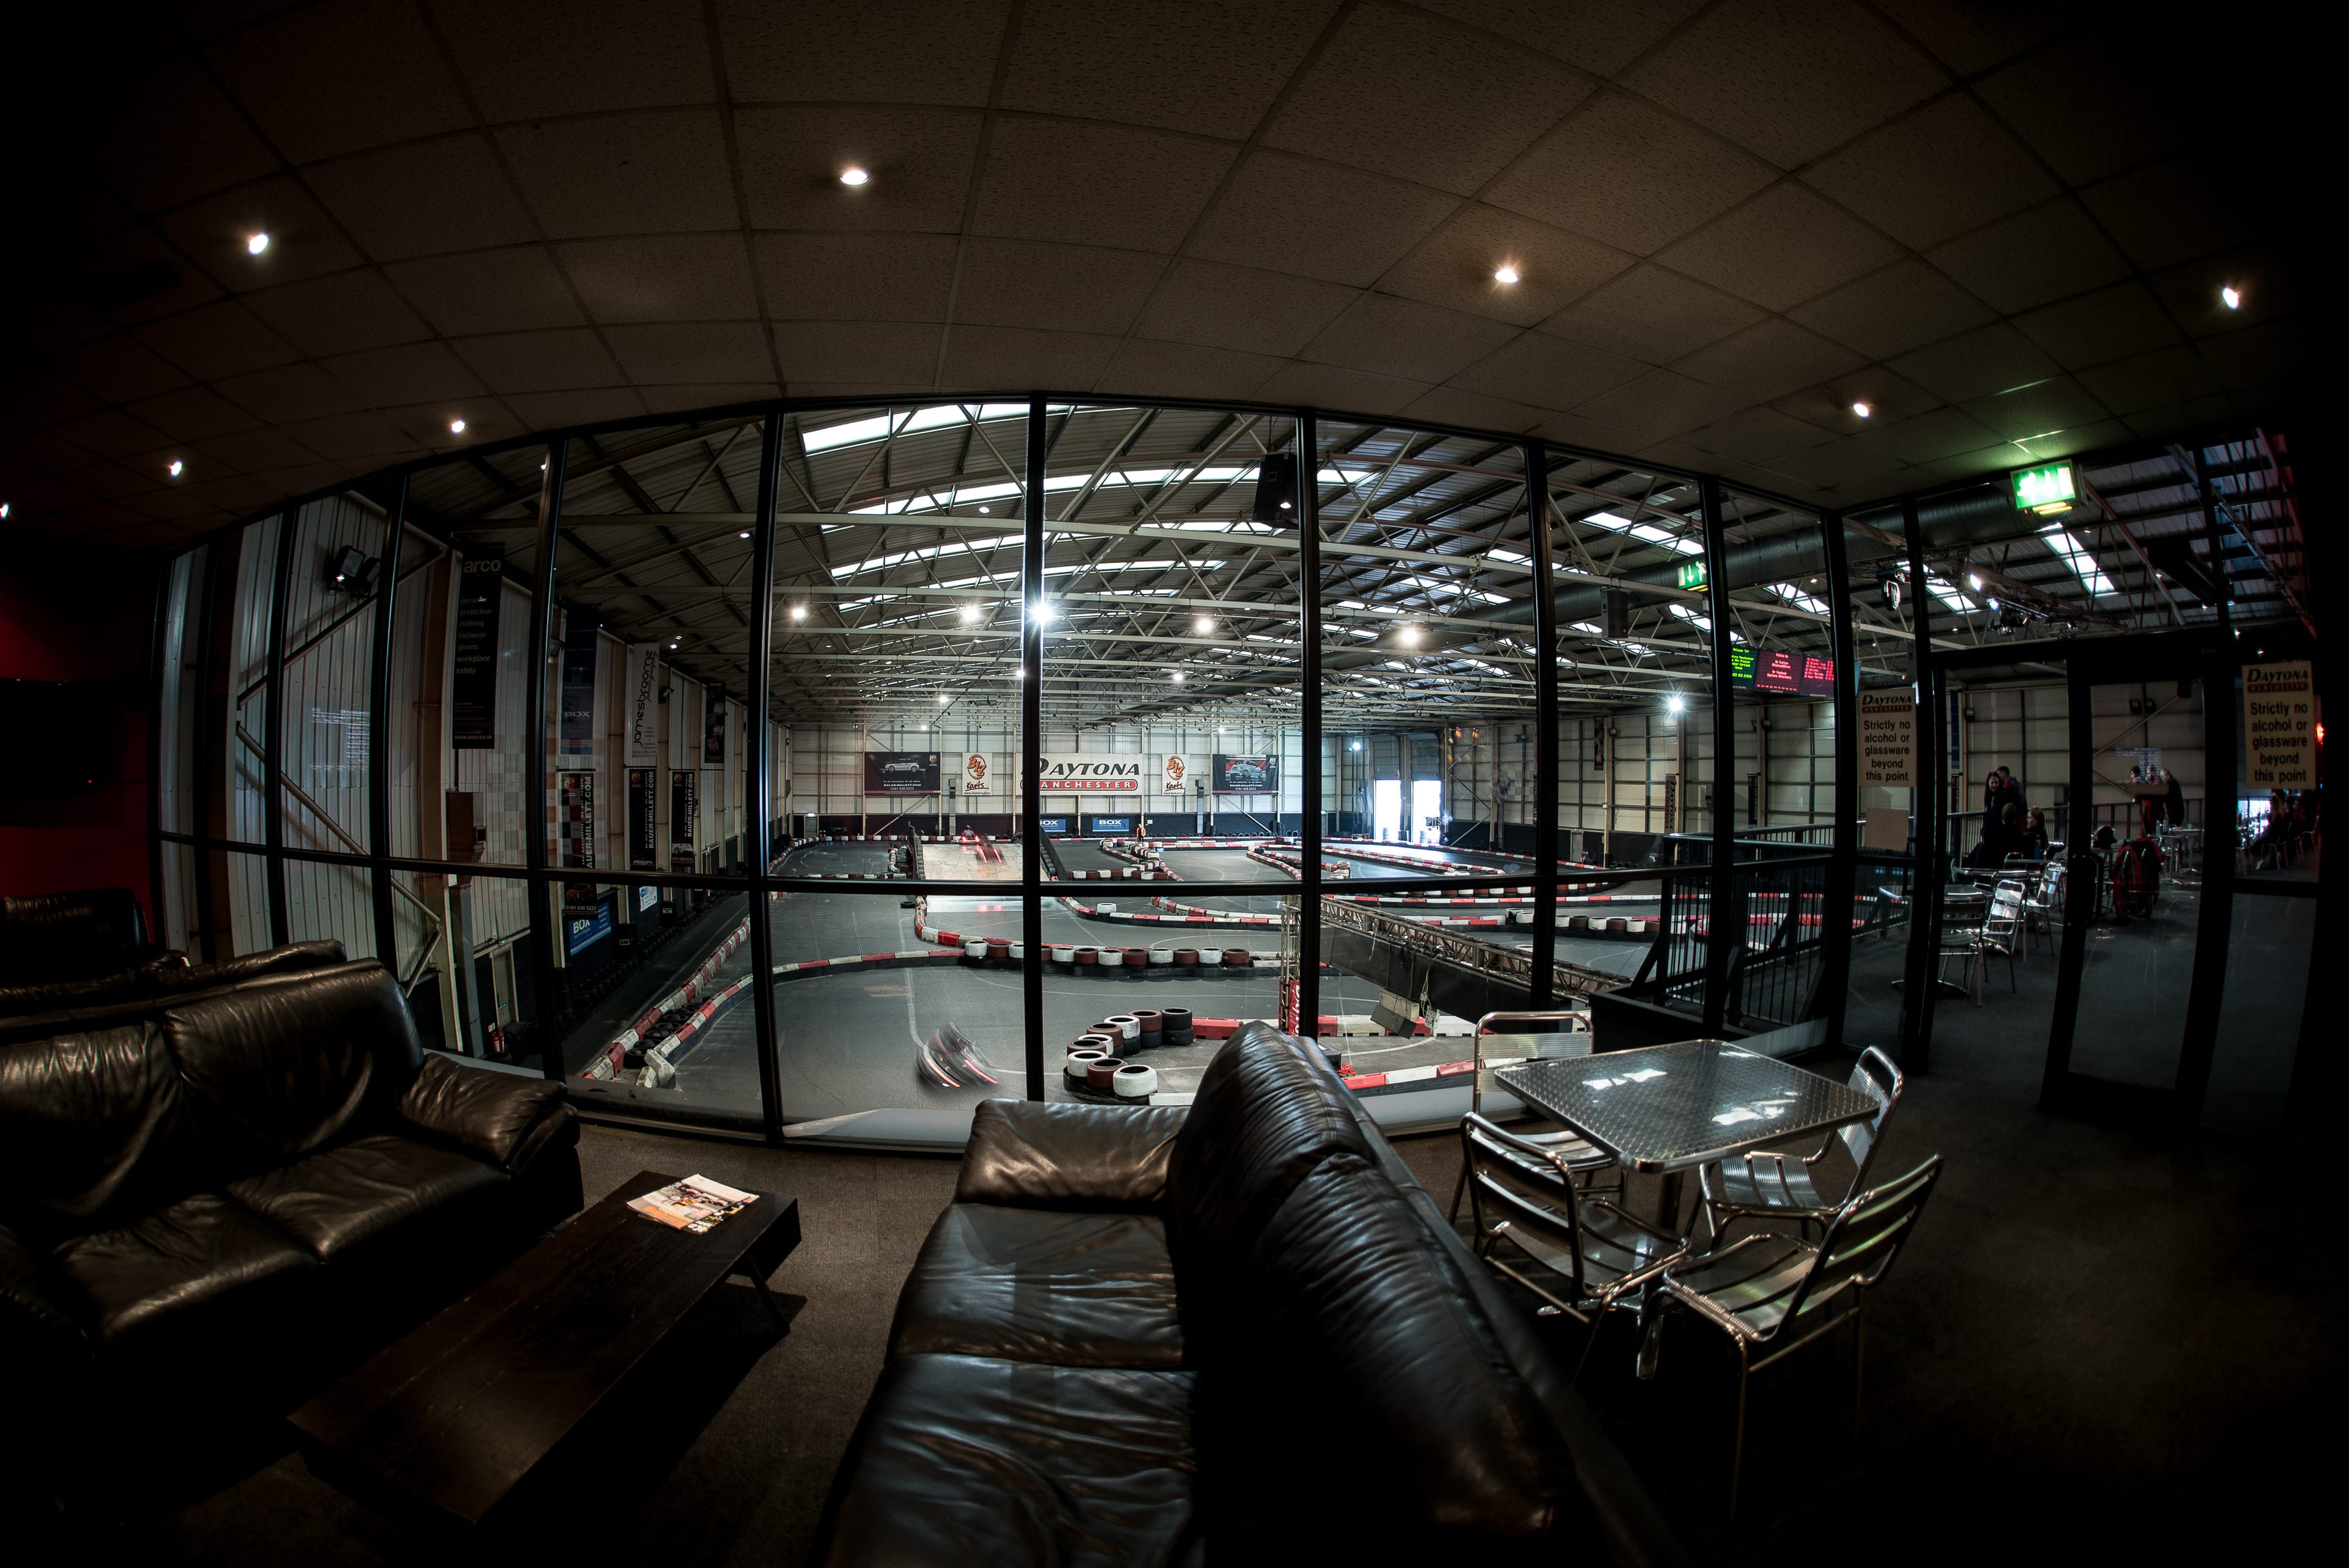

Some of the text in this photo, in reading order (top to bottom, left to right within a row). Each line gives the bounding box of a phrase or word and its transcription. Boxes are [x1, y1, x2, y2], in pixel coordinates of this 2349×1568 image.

[463, 559, 502, 573] arco
[457, 643, 478, 652] gloves
[456, 655, 491, 663] workplace
[2247, 669, 2308, 684] DAYTONA
[1861, 694, 1912, 705] DAYTONA
[2251, 702, 2308, 716] Strictly no
[1864, 719, 1910, 731] Strictly no
[2252, 719, 2307, 732] alcohol or
[1865, 733, 1896, 743] alcohol
[2252, 735, 2307, 751] glassware
[1865, 745, 1910, 757] glassware
[1871, 758, 1903, 770] beyond
[2260, 752, 2299, 766] beyond
[967, 757, 987, 776] BIZ
[1167, 759, 1185, 777] BIZ
[1866, 770, 1909, 782] this point
[2254, 769, 2306, 784] this point
[966, 780, 984, 789] Karts
[1166, 781, 1183, 790] Karts
[584, 776, 593, 869] AUER-MILLETT.COM
[1427, 817, 1442, 826] PITS
